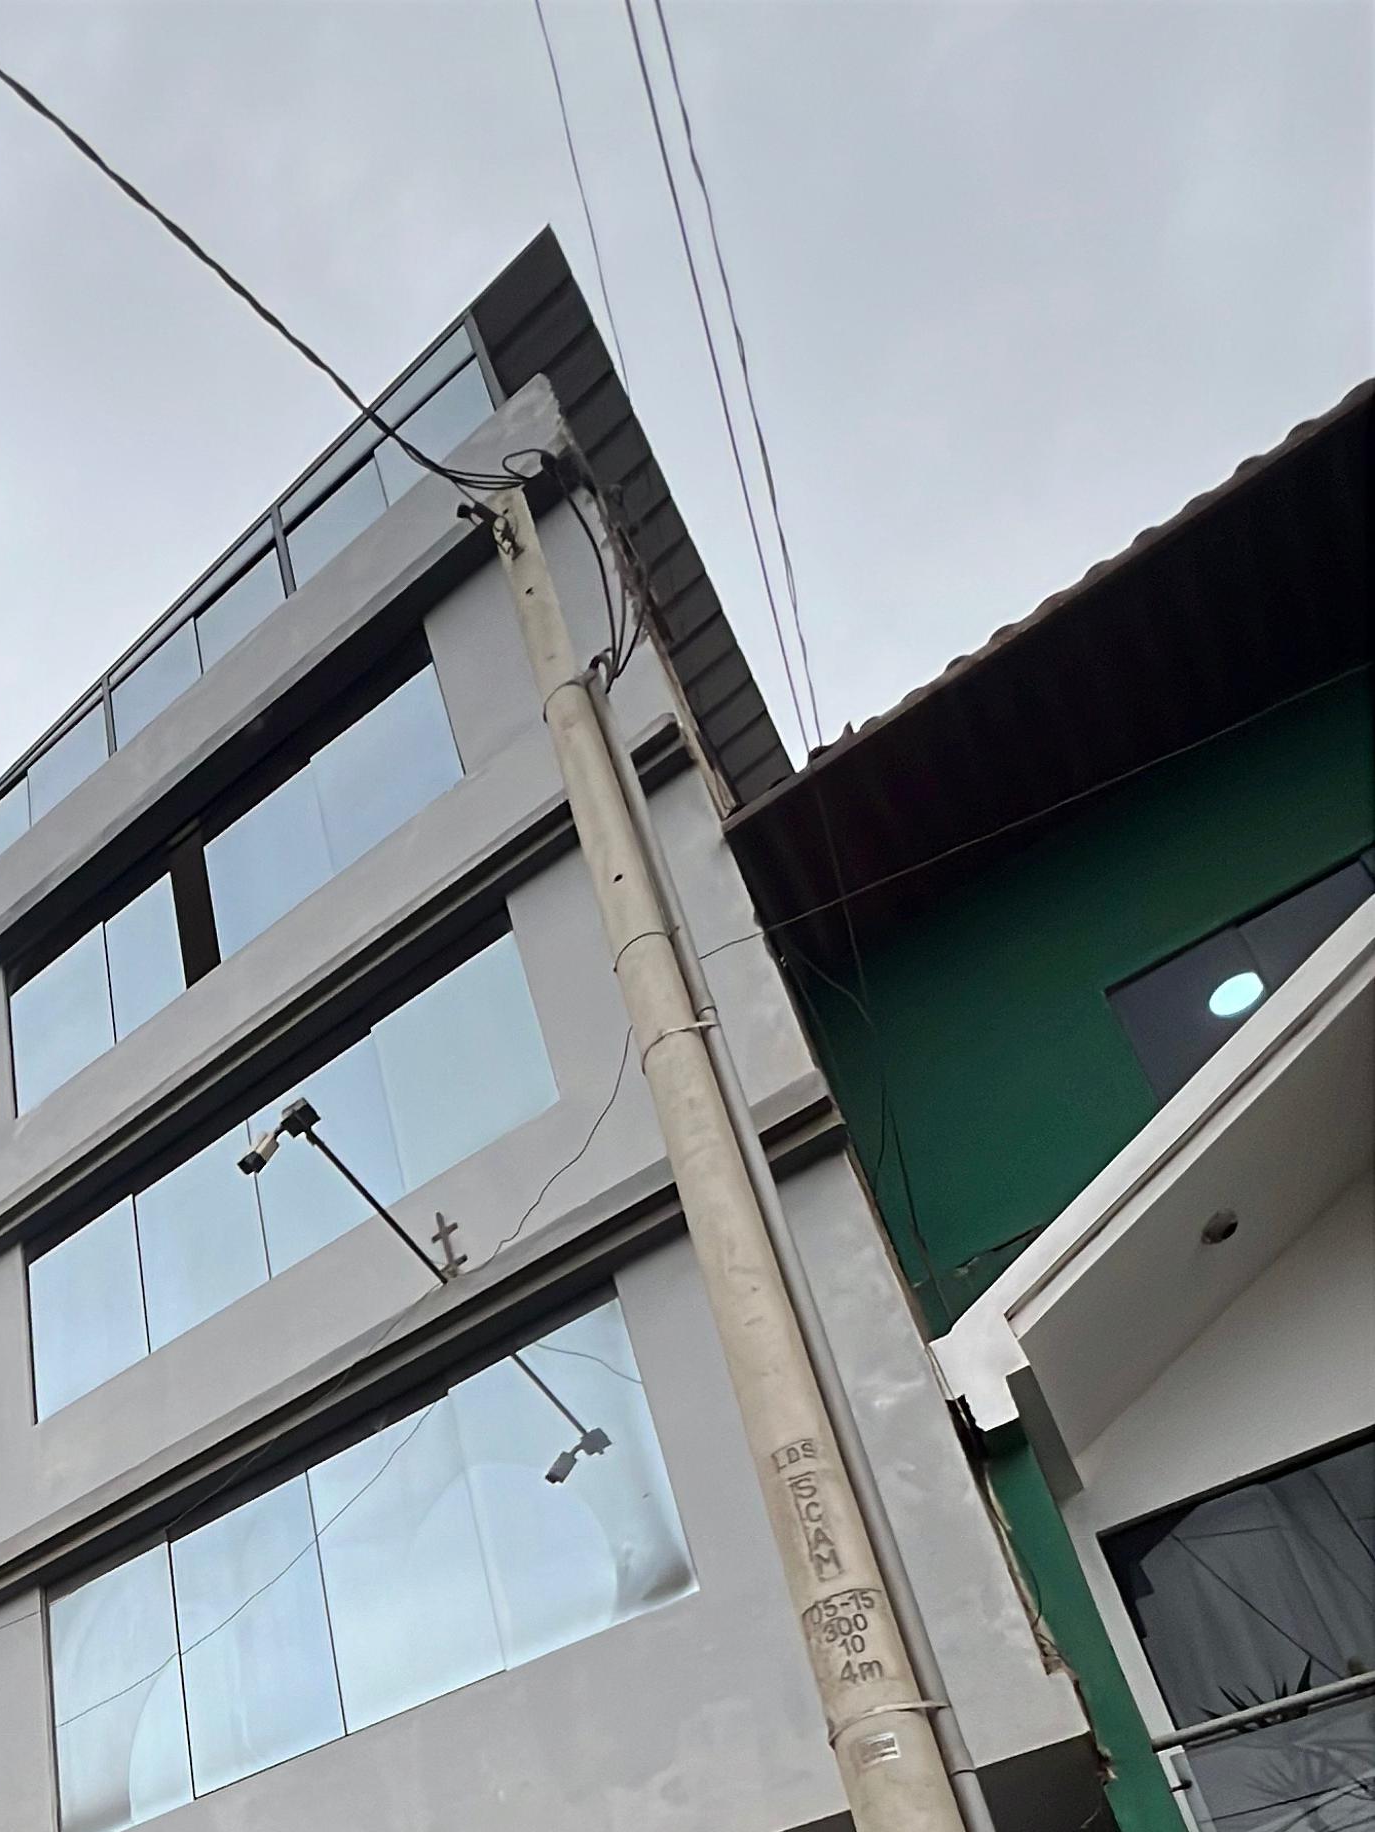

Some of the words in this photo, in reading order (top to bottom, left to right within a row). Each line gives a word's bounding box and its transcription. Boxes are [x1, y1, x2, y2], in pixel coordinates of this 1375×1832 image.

[824, 1613, 868, 1643] 300
[839, 1634, 866, 1657] 10
[840, 1659, 885, 1684] 4m
